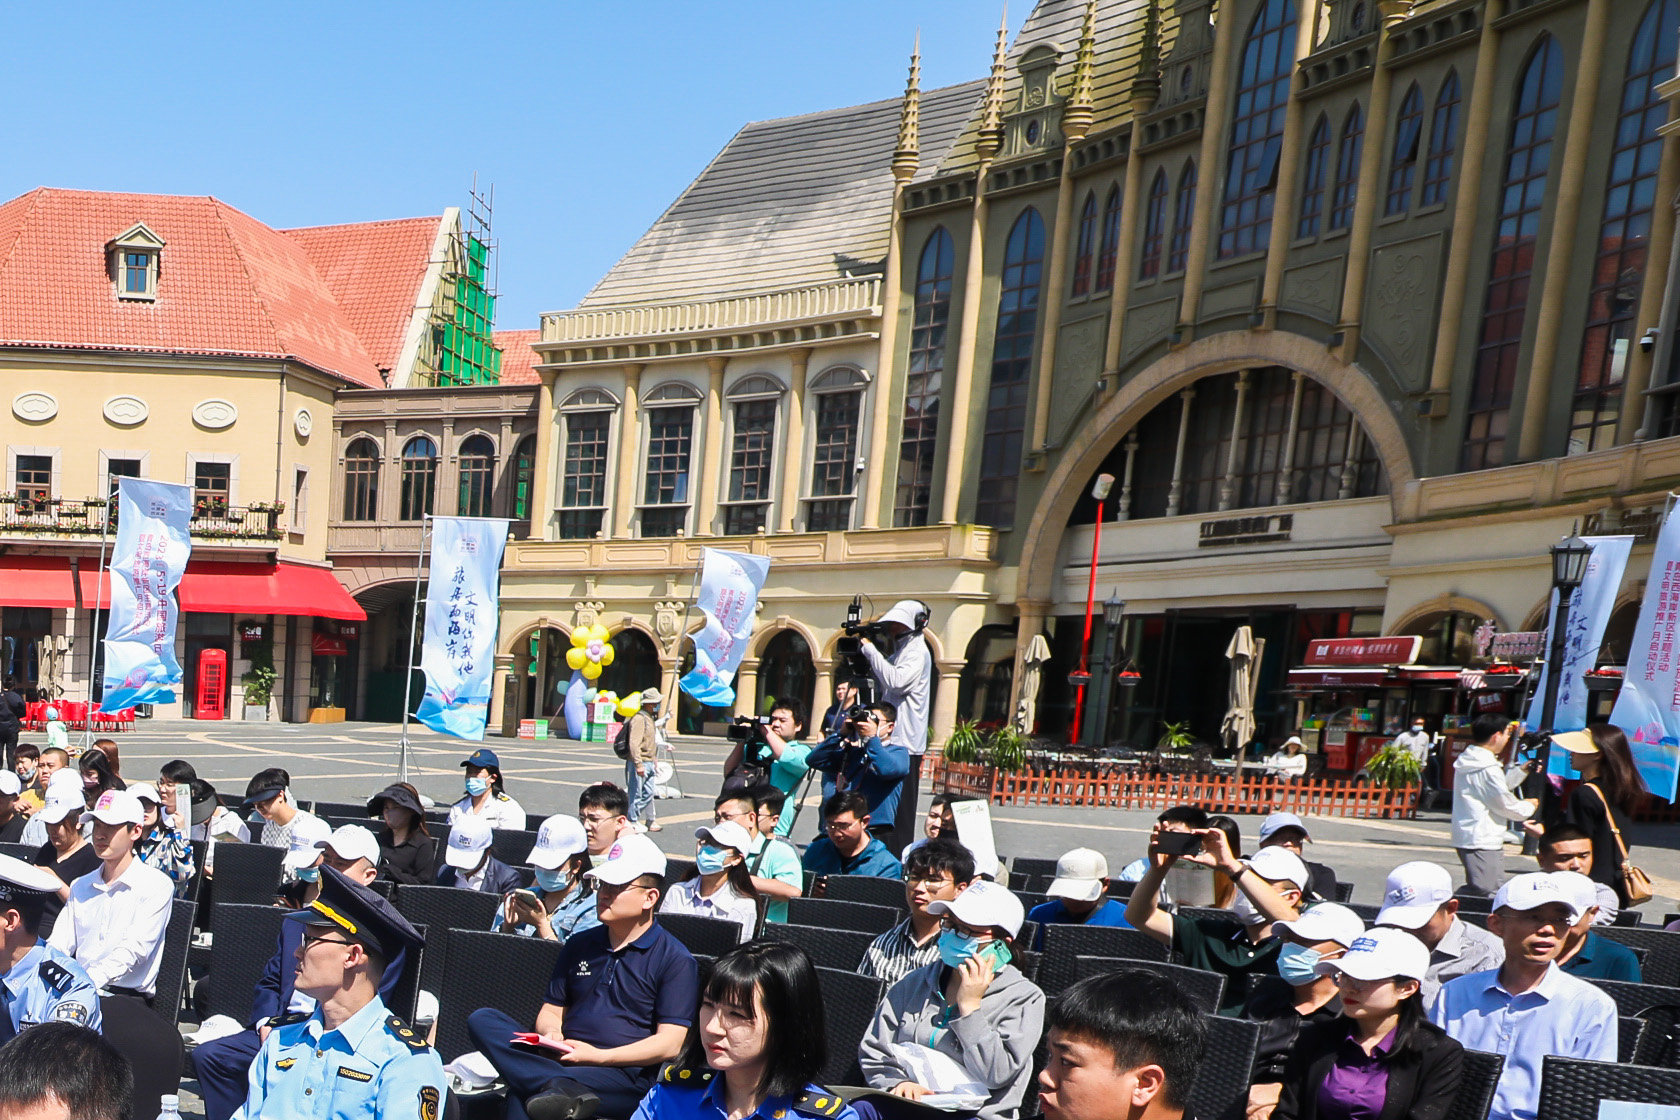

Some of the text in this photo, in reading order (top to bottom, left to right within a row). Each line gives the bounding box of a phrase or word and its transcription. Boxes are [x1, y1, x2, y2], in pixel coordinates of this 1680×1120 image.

[445, 566, 465, 660] 旅居西海岸
[458, 591, 479, 676] 文明你我他
[1644, 560, 1674, 682] 暨文明旅游推广月启动仪式
